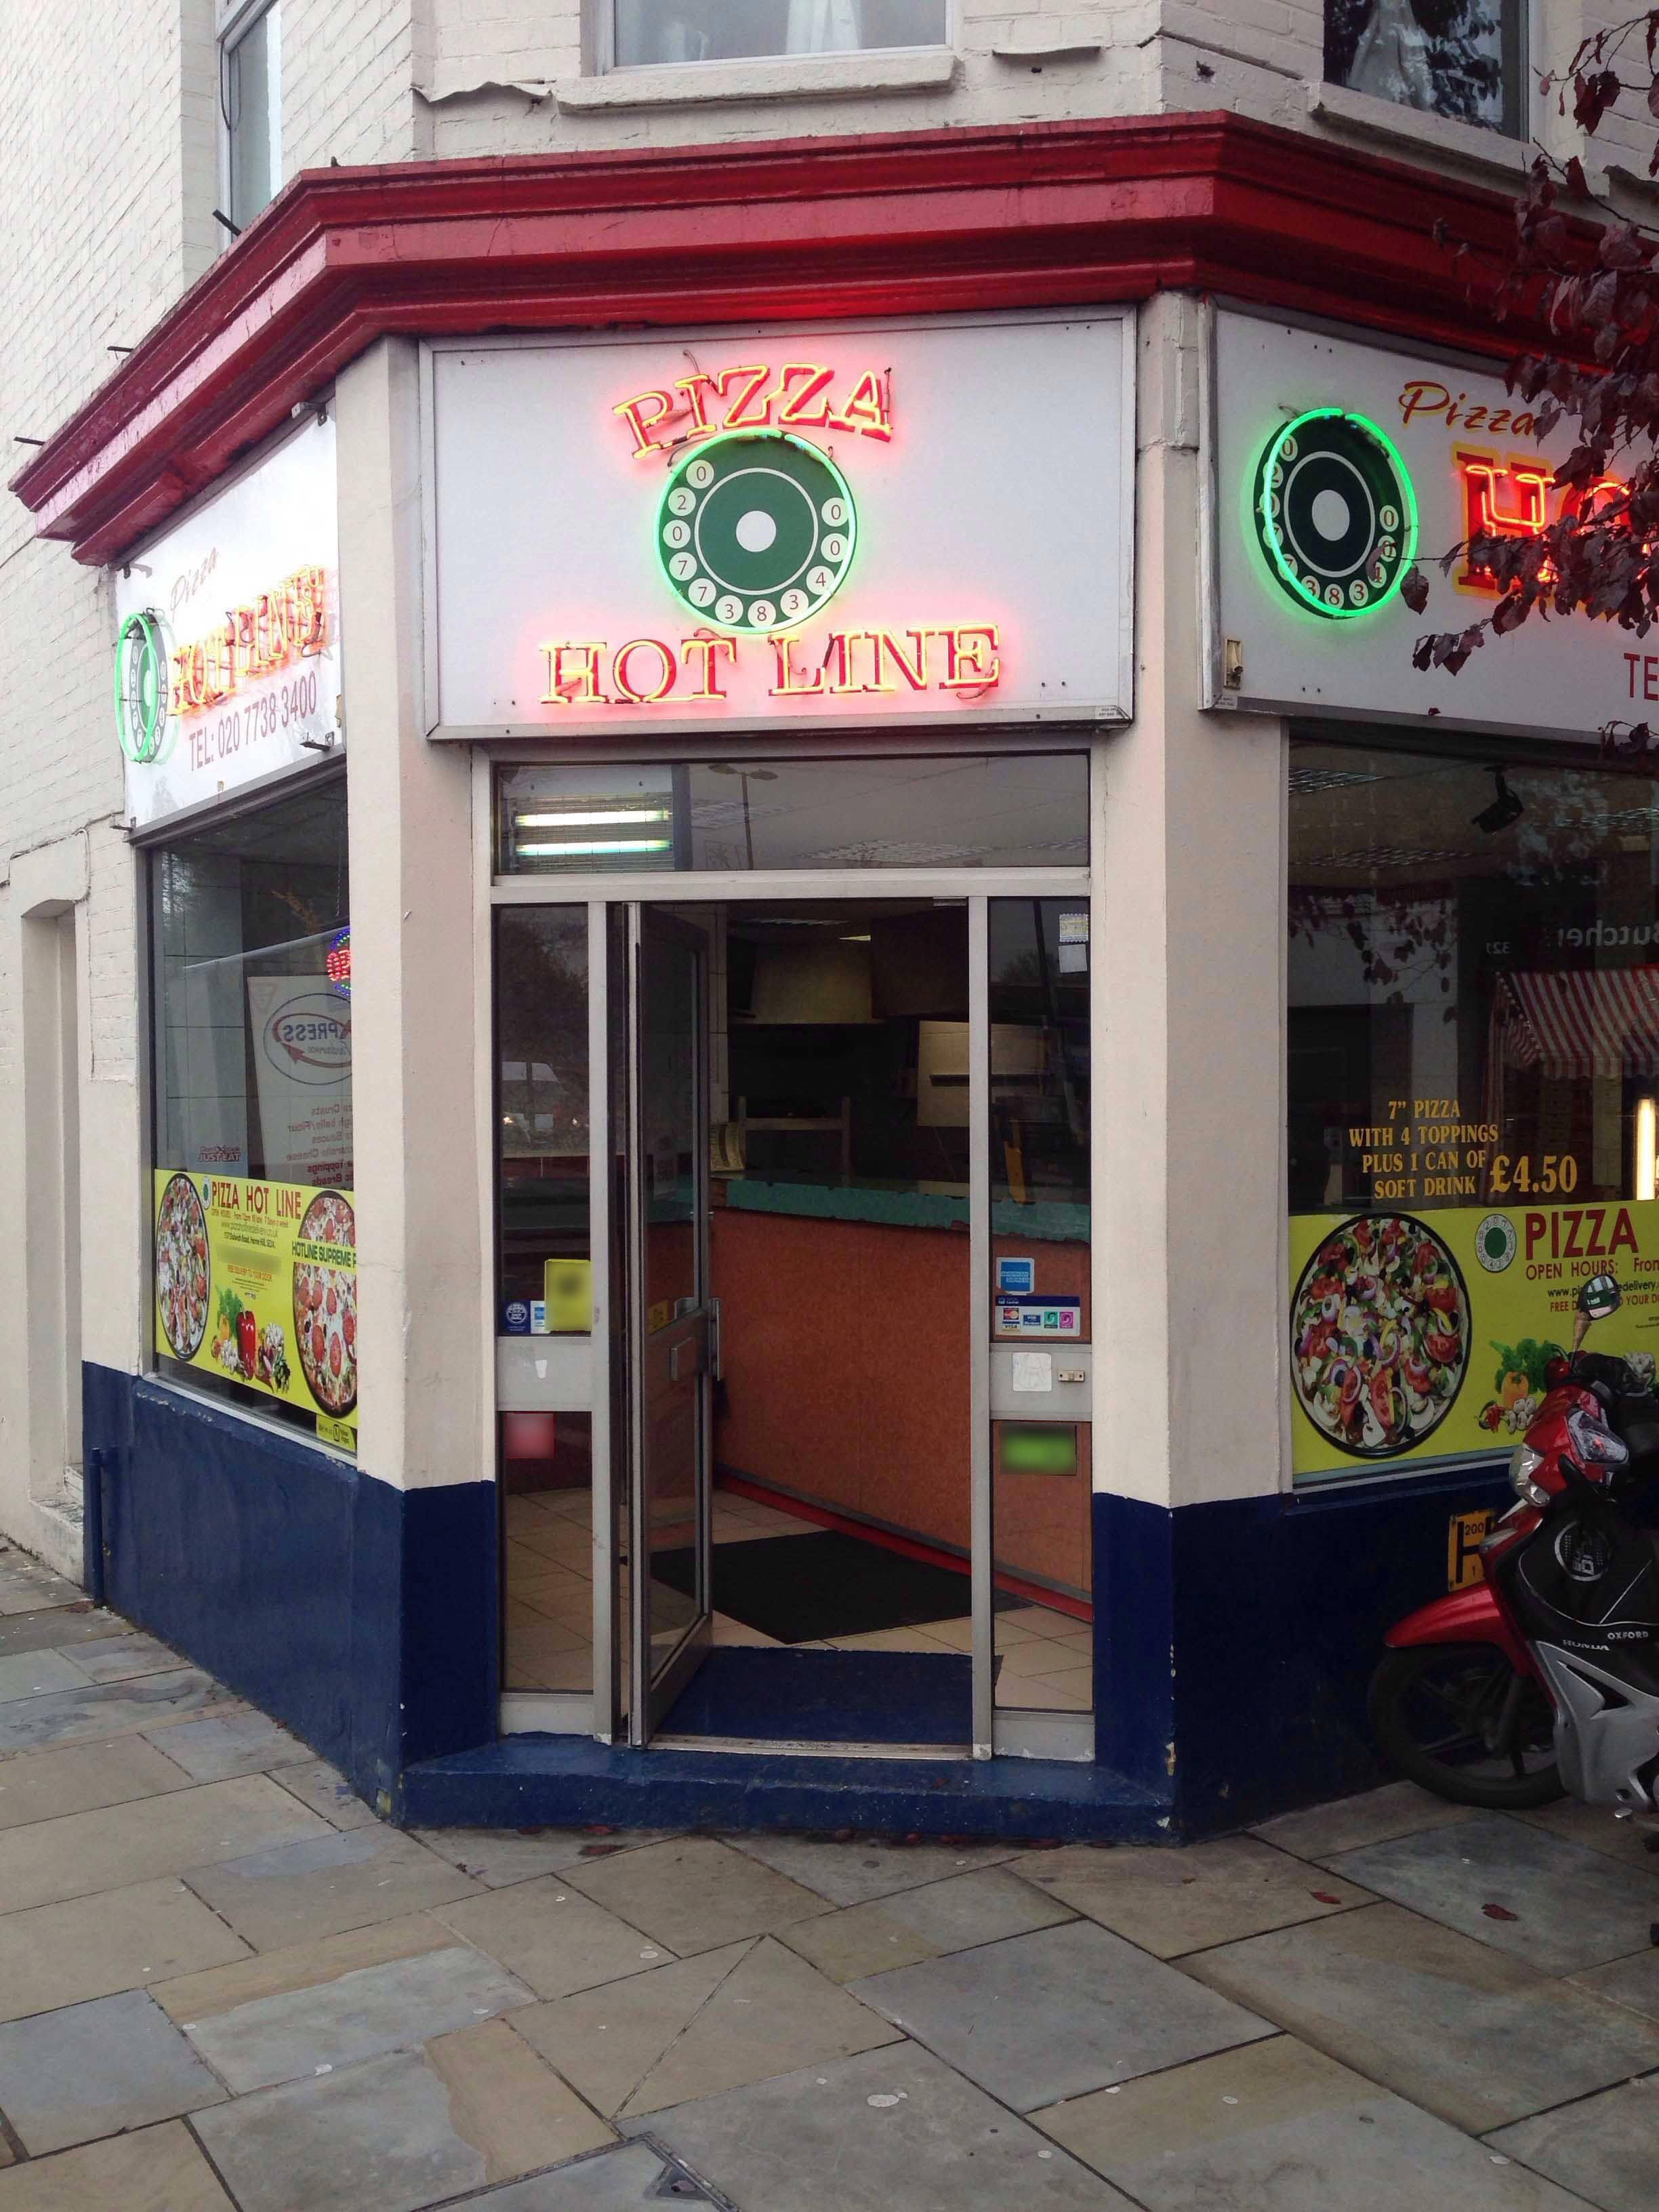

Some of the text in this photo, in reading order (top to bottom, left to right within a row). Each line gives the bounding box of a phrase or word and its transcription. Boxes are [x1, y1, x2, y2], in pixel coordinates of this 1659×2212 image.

[613, 362, 892, 459] PIZZA
[1398, 380, 1534, 436] Pizza
[539, 624, 1000, 703] HOT LINE
[189, 671, 316, 771] TEL: 020 7738 3400
[1414, 1100, 1460, 1118] PIZZA
[1349, 1124, 1499, 1147] WITH 4 TOPPINGS
[1362, 1150, 1486, 1173] PLUS 1 CAN OF
[1490, 1155, 1578, 1193] £4.50
[1374, 1176, 1476, 1200] SOFT DRINK
[212, 1181, 239, 1210] PIZZA
[246, 1185, 269, 1214] HOT
[276, 1189, 302, 1220] LINE
[1525, 1208, 1639, 1260] PIZZA
[291, 1242, 317, 1261] HOTLINE
[319, 1246, 351, 1267] SUPREME
[1526, 1263, 1562, 1280] OPEN
[1571, 1258, 1618, 1277] HOURS:
[1550, 1300, 1570, 1313] FREE
[1626, 1294, 1649, 1306] YOUR
[1465, 1522, 1485, 1536] 200
[1562, 1639, 1610, 1652] HONDA
[1607, 1631, 1649, 1640] OXFORD
